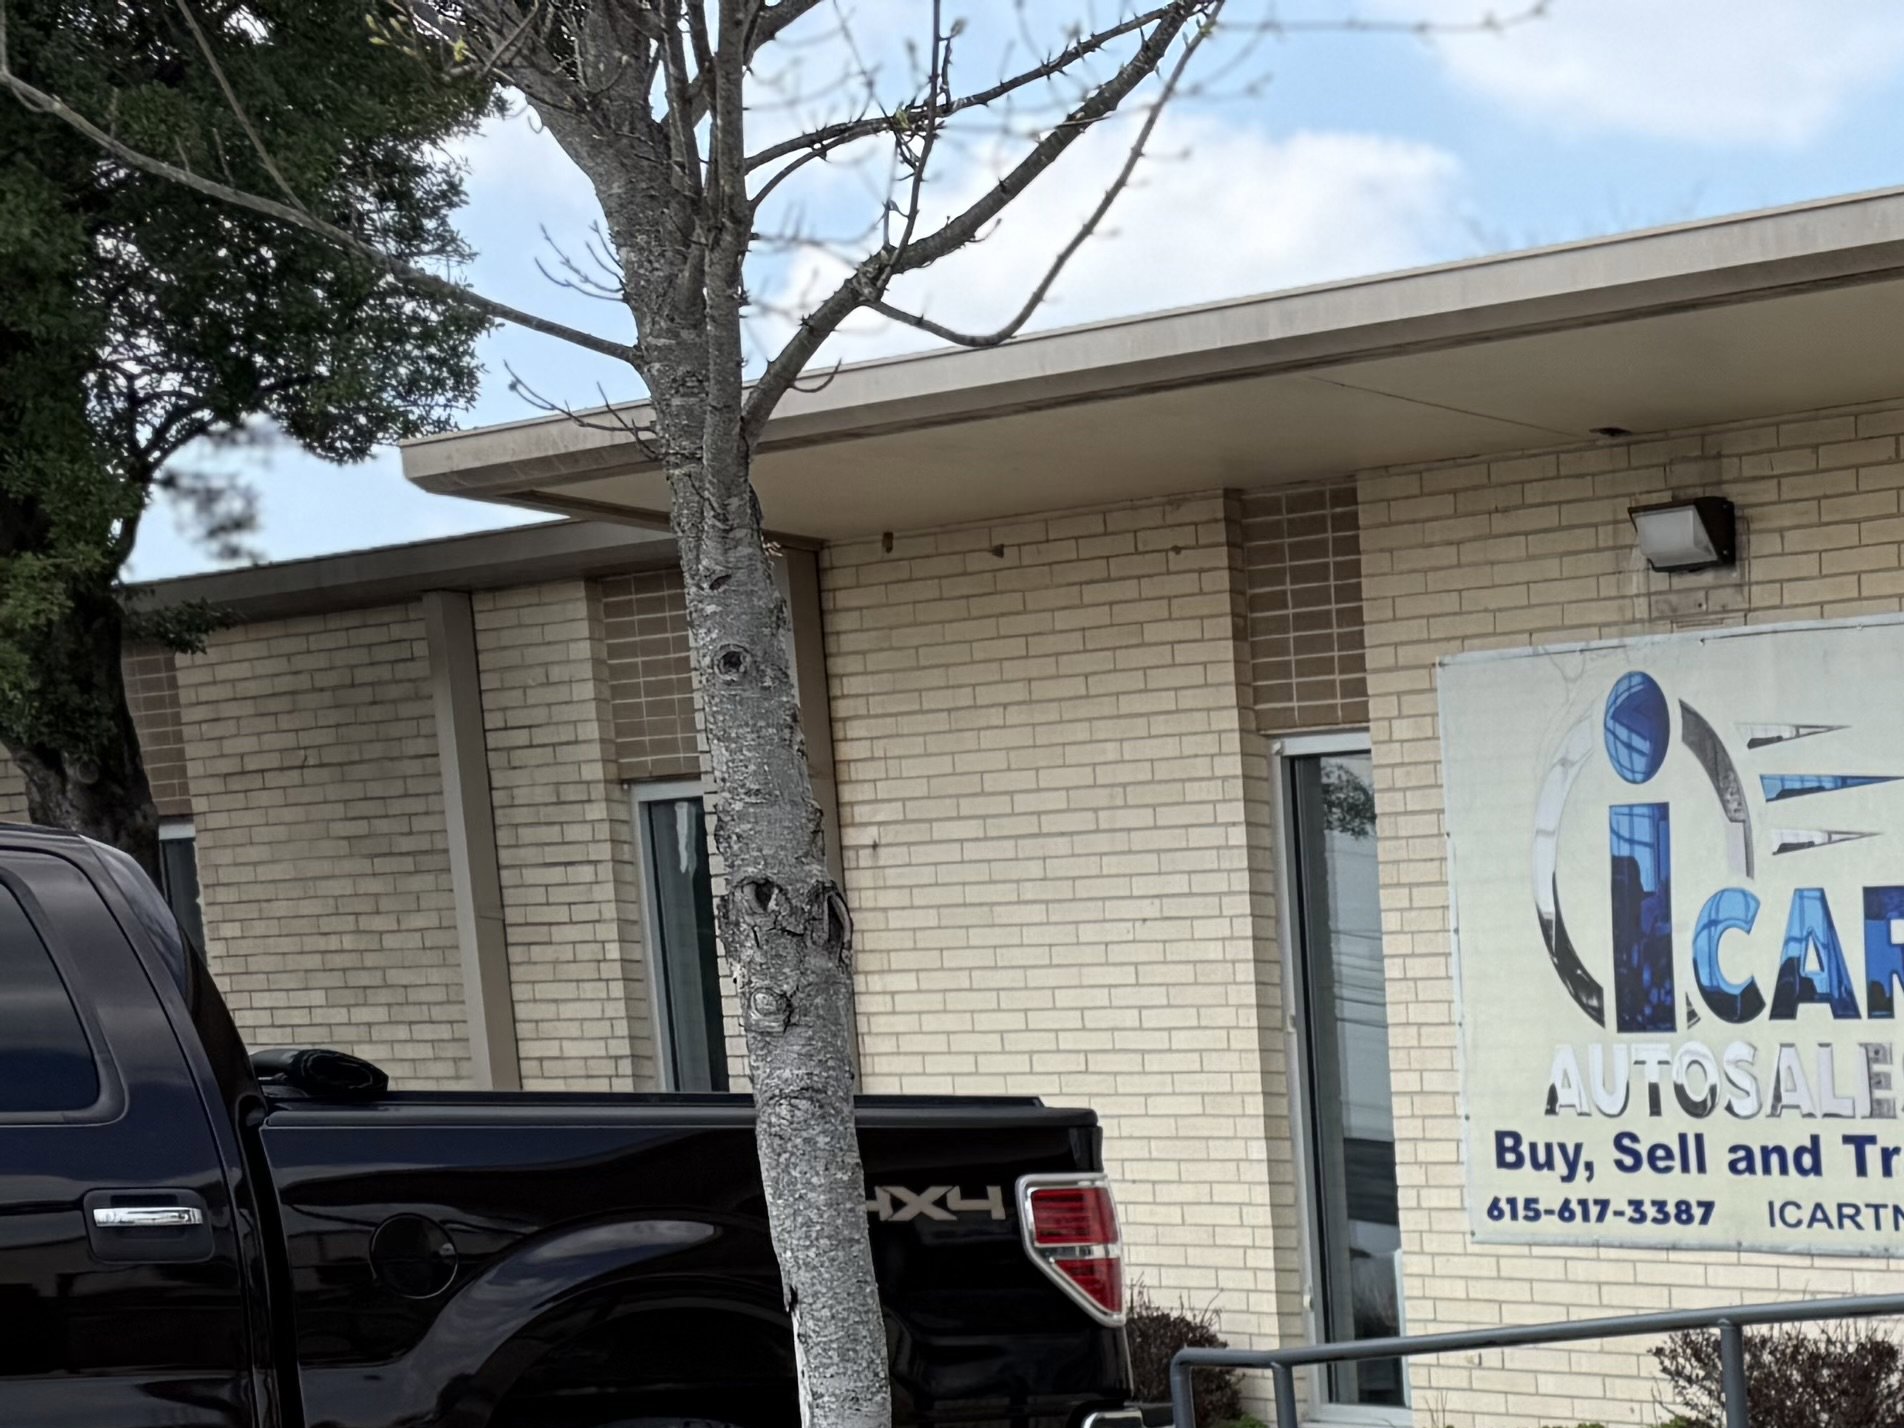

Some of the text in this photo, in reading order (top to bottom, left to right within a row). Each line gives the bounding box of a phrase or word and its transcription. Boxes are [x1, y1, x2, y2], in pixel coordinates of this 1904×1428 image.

[1494, 1130, 1595, 1183] Buy,
[1612, 1133, 1707, 1175] Sell
[1727, 1134, 1823, 1178] and
[1486, 1197, 1716, 1226] 615-617-3387
